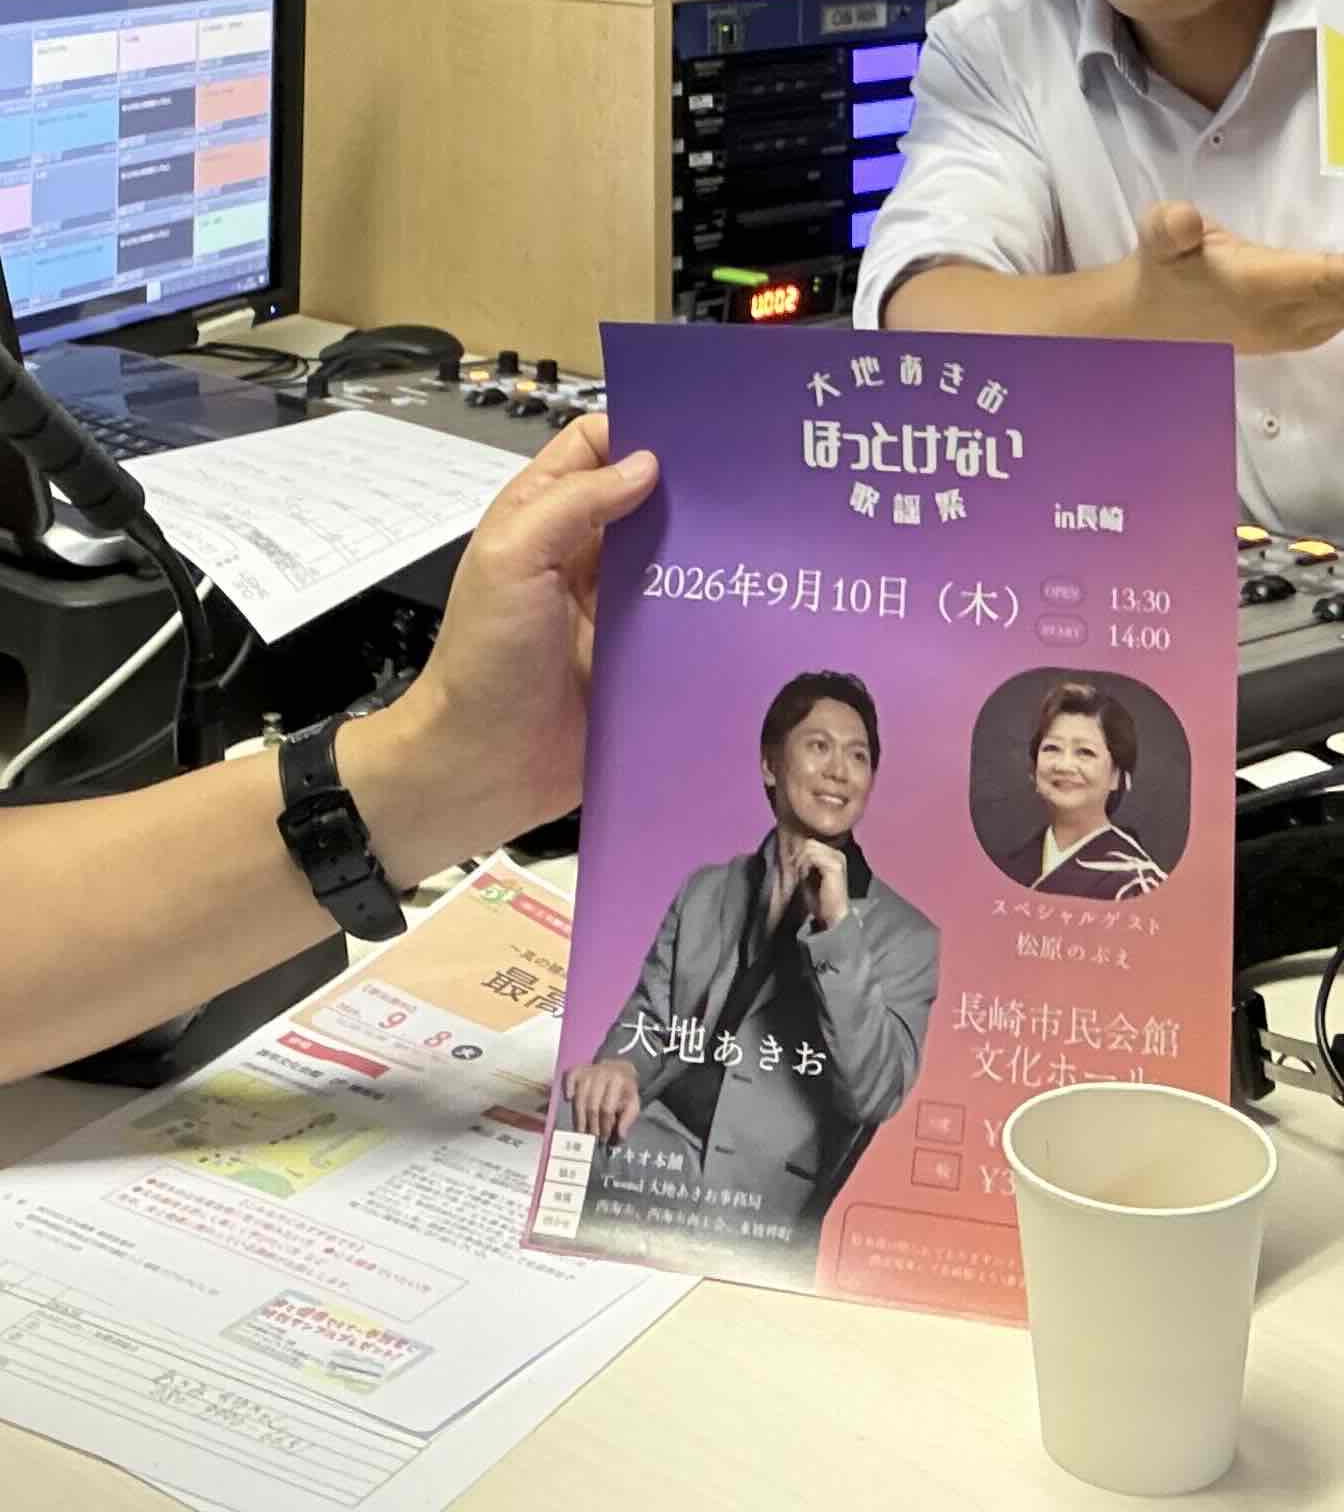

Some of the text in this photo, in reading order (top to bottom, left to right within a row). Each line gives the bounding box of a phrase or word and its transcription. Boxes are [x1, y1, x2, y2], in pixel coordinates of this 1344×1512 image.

[807, 354, 1009, 414] 大地あきお
[802, 419, 1024, 479] ほっとけない
[1054, 503, 1124, 532] in長崎
[1110, 586, 1171, 615] 13:30
[1109, 623, 1171, 651] 14:00
[991, 899, 1160, 936] スペシャルゲスト
[1016, 931, 1131, 970] 松原のぶえ
[618, 1010, 827, 1077] 大地あきお
[951, 991, 1182, 1058] 長崎市民会館
